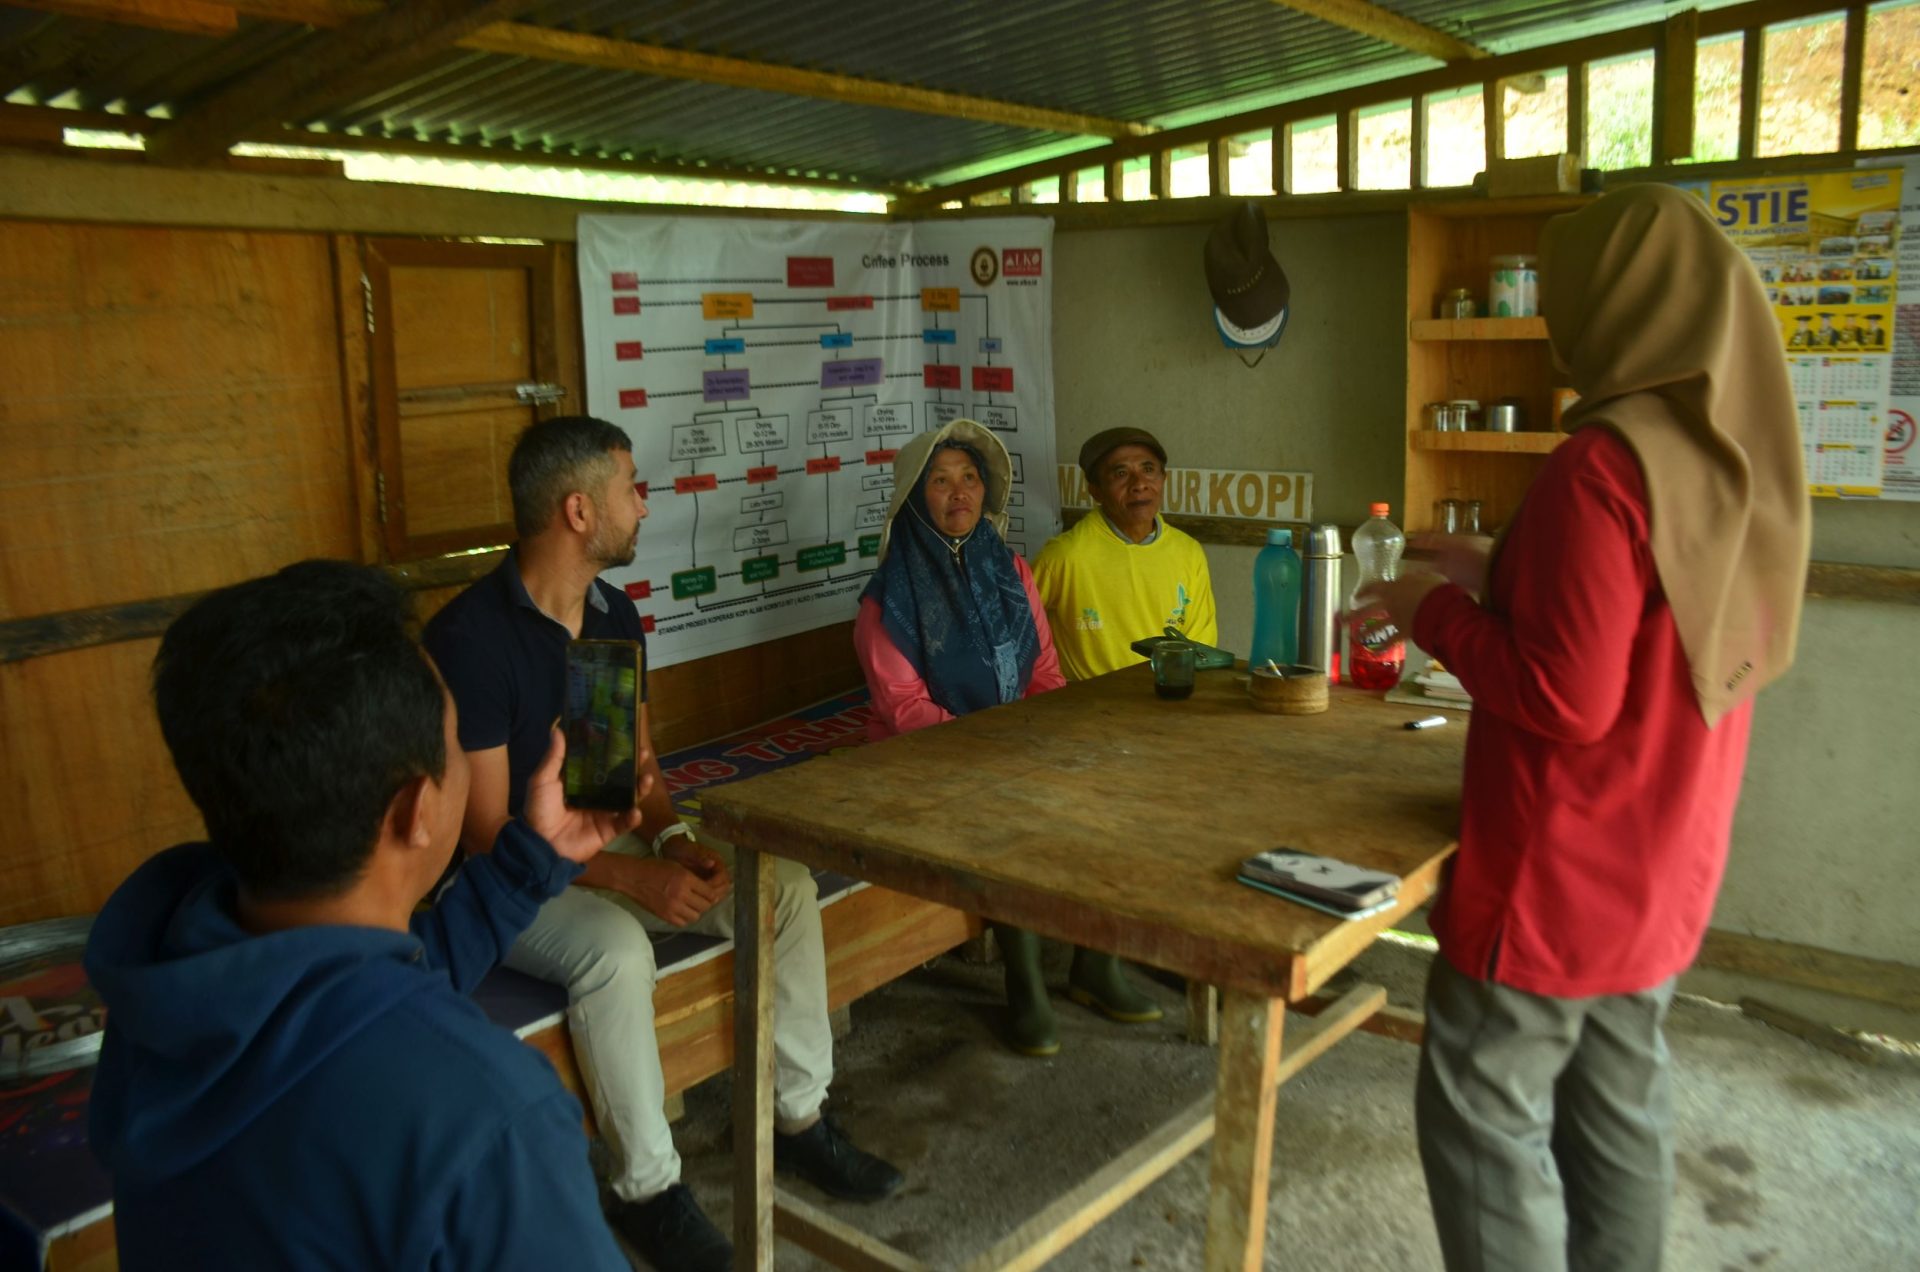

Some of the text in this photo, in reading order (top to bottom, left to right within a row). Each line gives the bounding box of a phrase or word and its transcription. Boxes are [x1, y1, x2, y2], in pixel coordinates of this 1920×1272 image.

[1717, 189, 1808, 226] STIE
[900, 252, 950, 268] Process
[1209, 472, 1305, 519] KOPI
